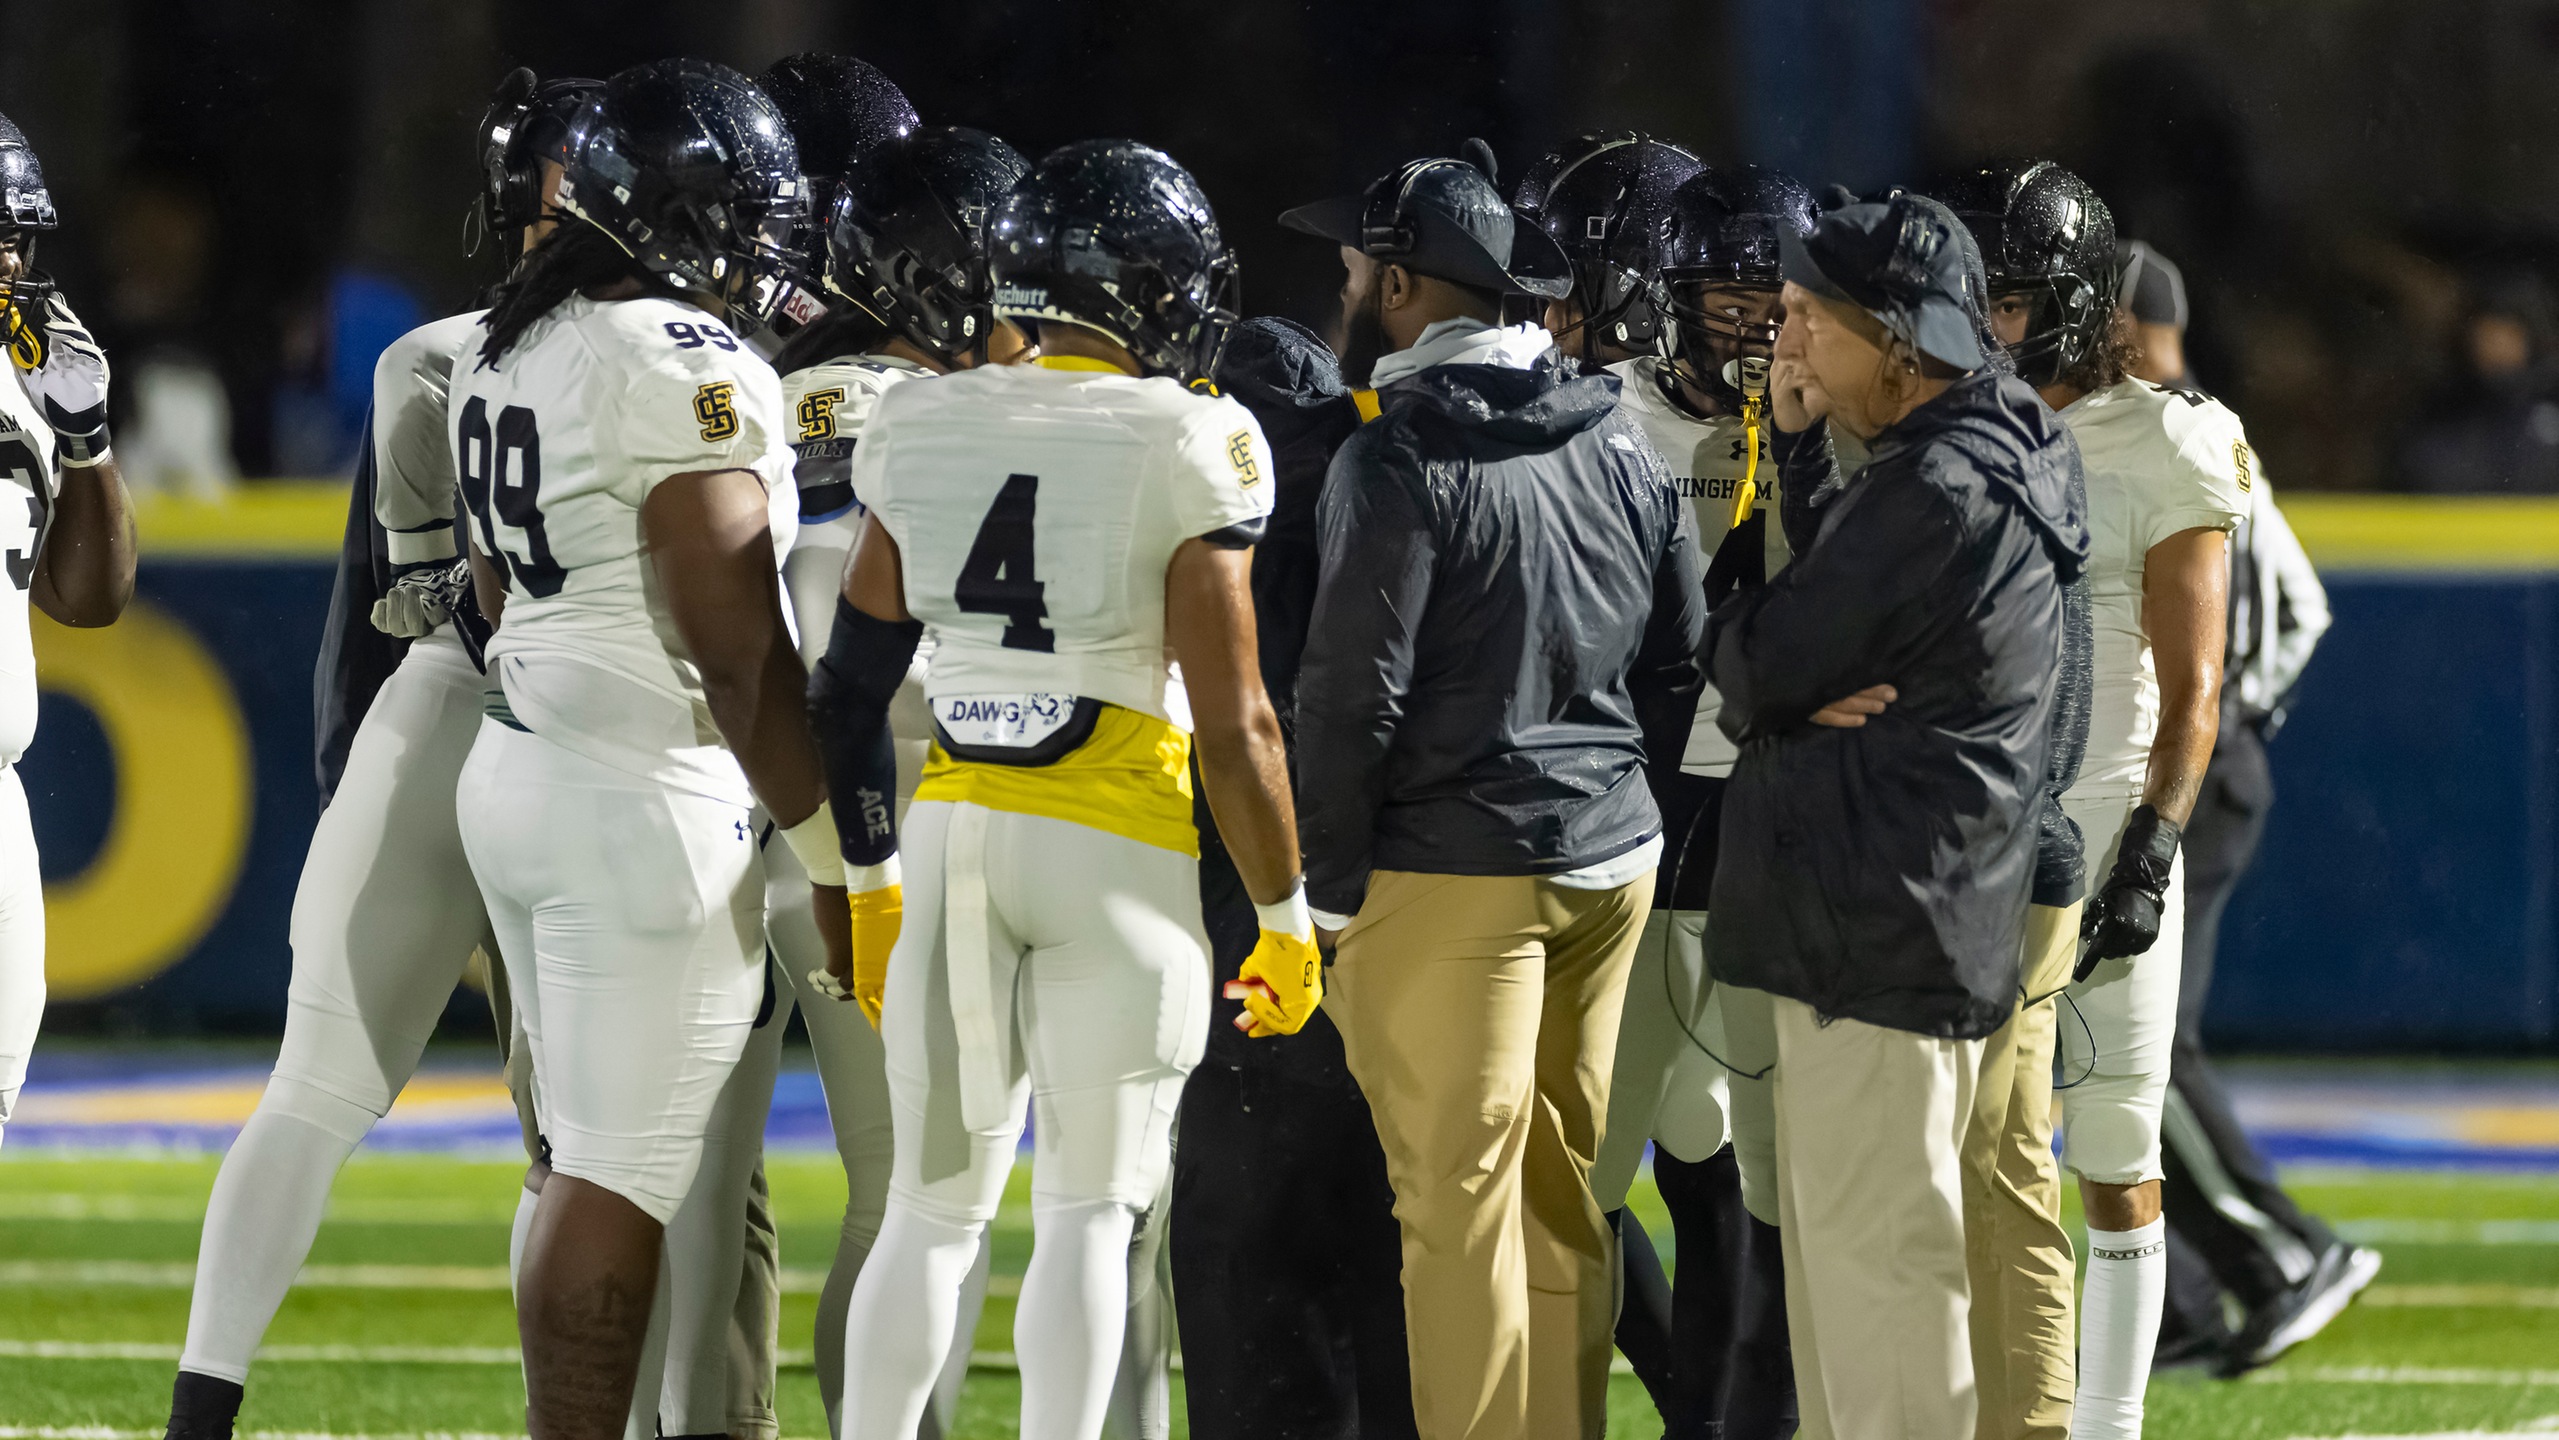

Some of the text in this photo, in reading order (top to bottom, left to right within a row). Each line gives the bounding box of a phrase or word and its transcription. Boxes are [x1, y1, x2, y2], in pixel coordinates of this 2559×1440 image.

[663, 322, 739, 352] 99
[458, 394, 569, 599] 99
[1676, 477, 1773, 500] INGHM
[954, 473, 1055, 654] 4
[953, 700, 1019, 723] DAWG
[857, 786, 890, 846] ACE
[2097, 1245, 2161, 1260] BATTLE
